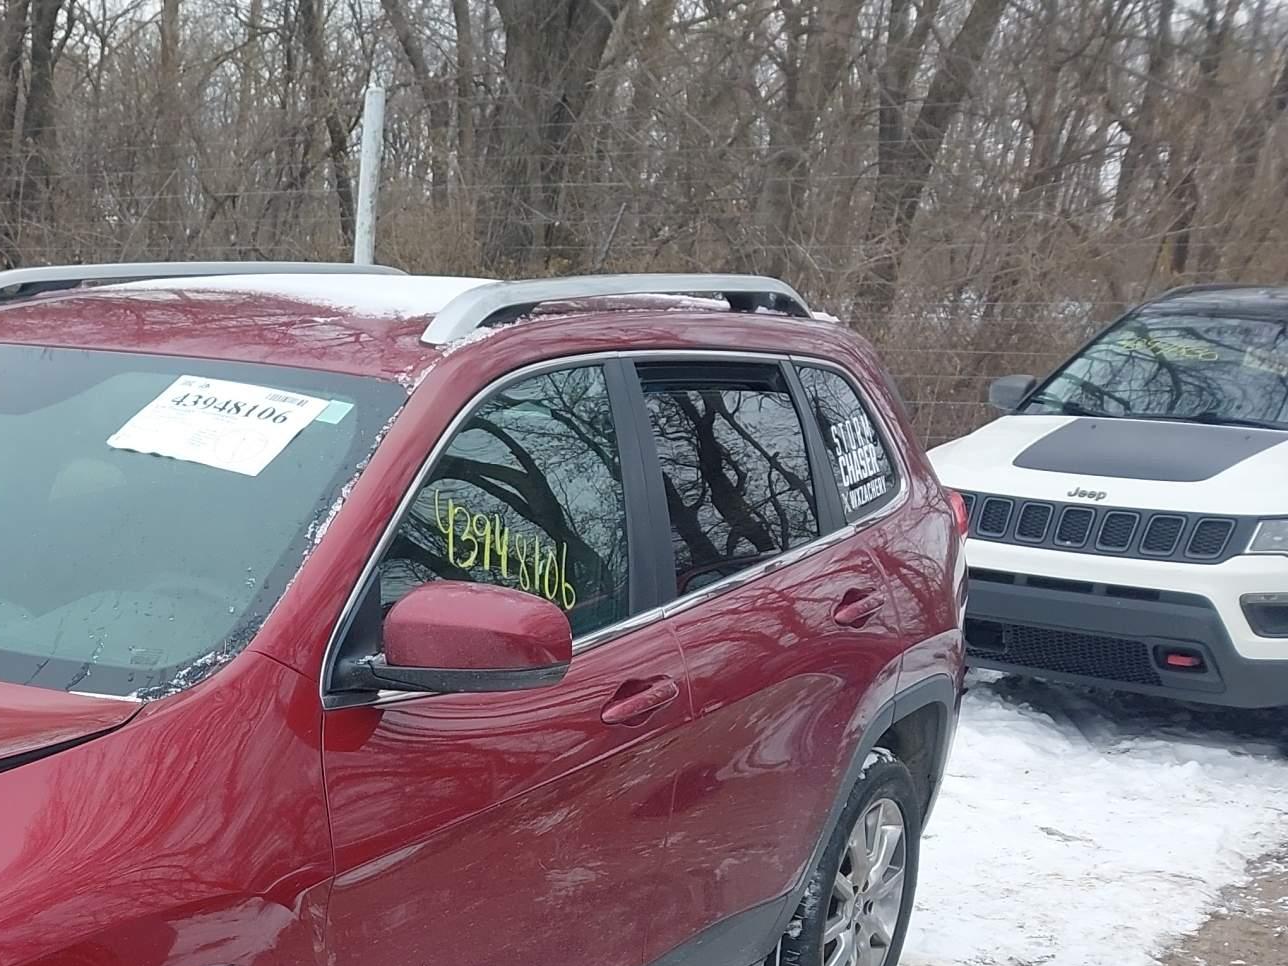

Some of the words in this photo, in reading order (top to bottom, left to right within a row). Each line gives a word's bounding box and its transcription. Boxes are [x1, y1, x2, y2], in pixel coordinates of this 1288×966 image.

[171, 392, 289, 424] 43948106
[830, 413, 873, 456] STORM
[838, 443, 880, 487] CHASER
[1067, 487, 1107, 501] Jeep
[435, 489, 576, 610] 43948106
